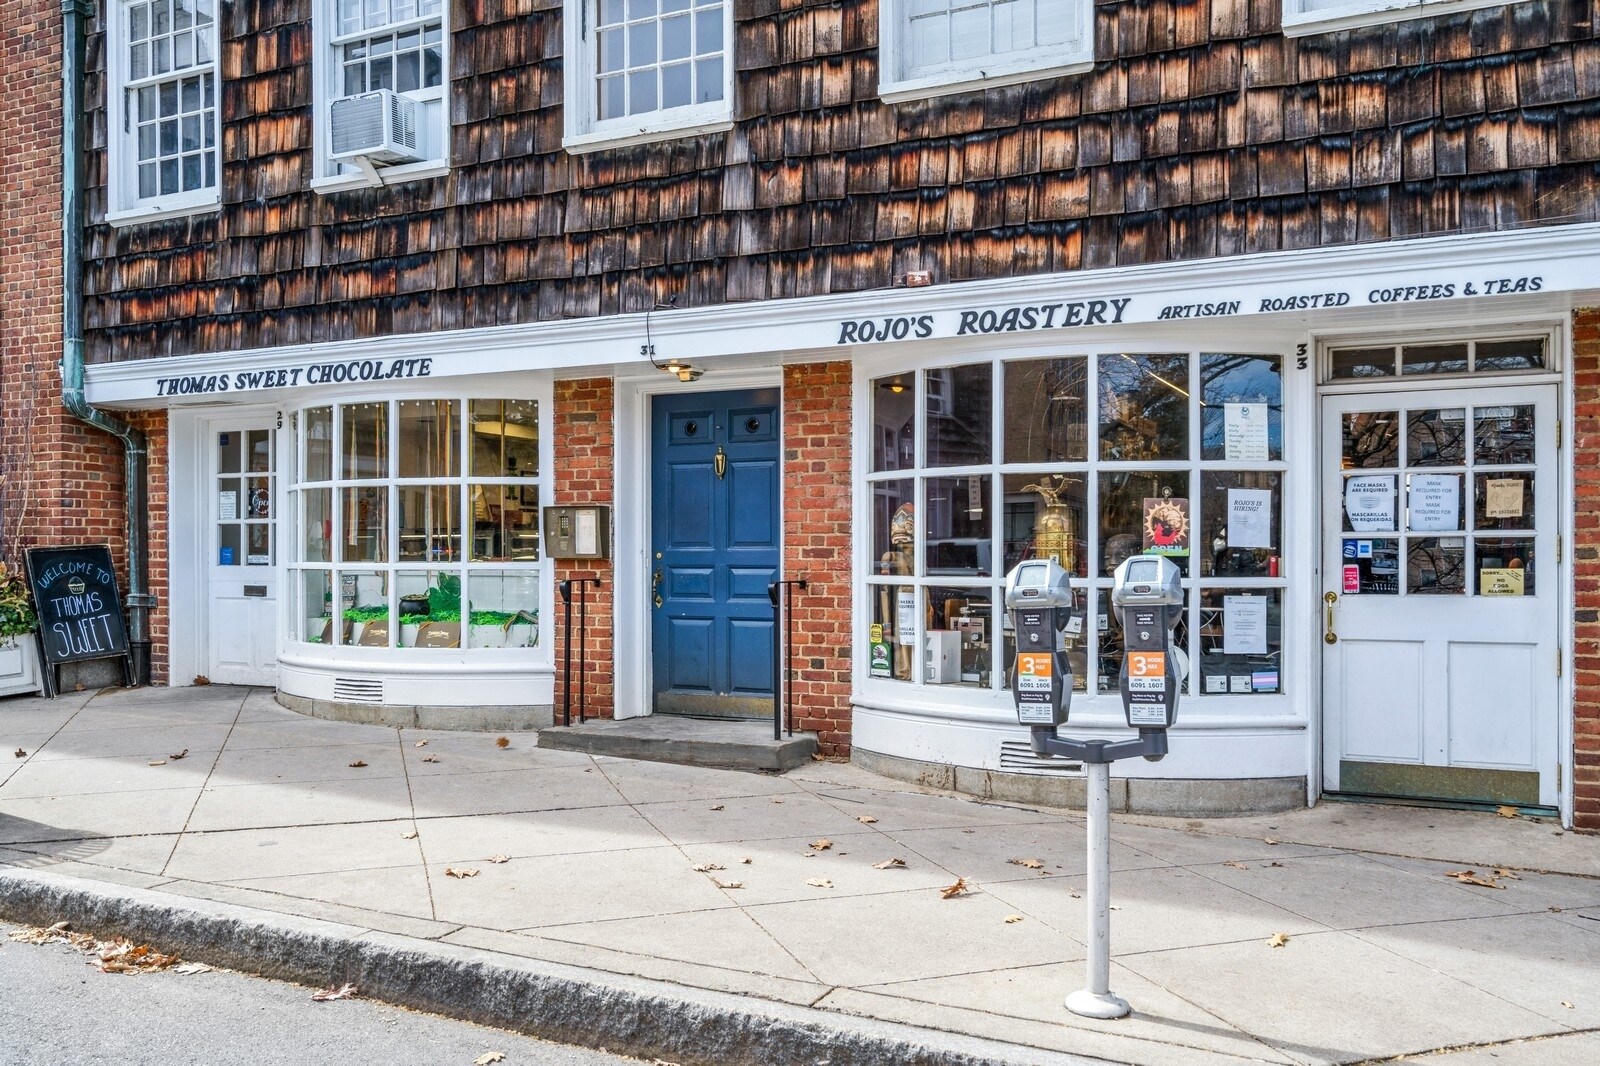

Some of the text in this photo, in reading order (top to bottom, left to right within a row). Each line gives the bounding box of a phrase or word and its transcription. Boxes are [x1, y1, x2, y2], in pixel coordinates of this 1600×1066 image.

[1157, 277, 1543, 320] ARTISAN ROASTED COFFEES & TEAS
[838, 298, 1131, 344] ROJO'S ROASTERY
[640, 345, 656, 355] 31
[157, 358, 433, 396] THOMAS SWEET CHOCOLATE
[1151, 545, 1184, 554] OPEN
[38, 562, 111, 589] WELCOME TO
[50, 592, 104, 617] THOMAS
[53, 613, 114, 657] SWEET
[1022, 657, 1035, 674] 3
[1133, 656, 1147, 676] 3
